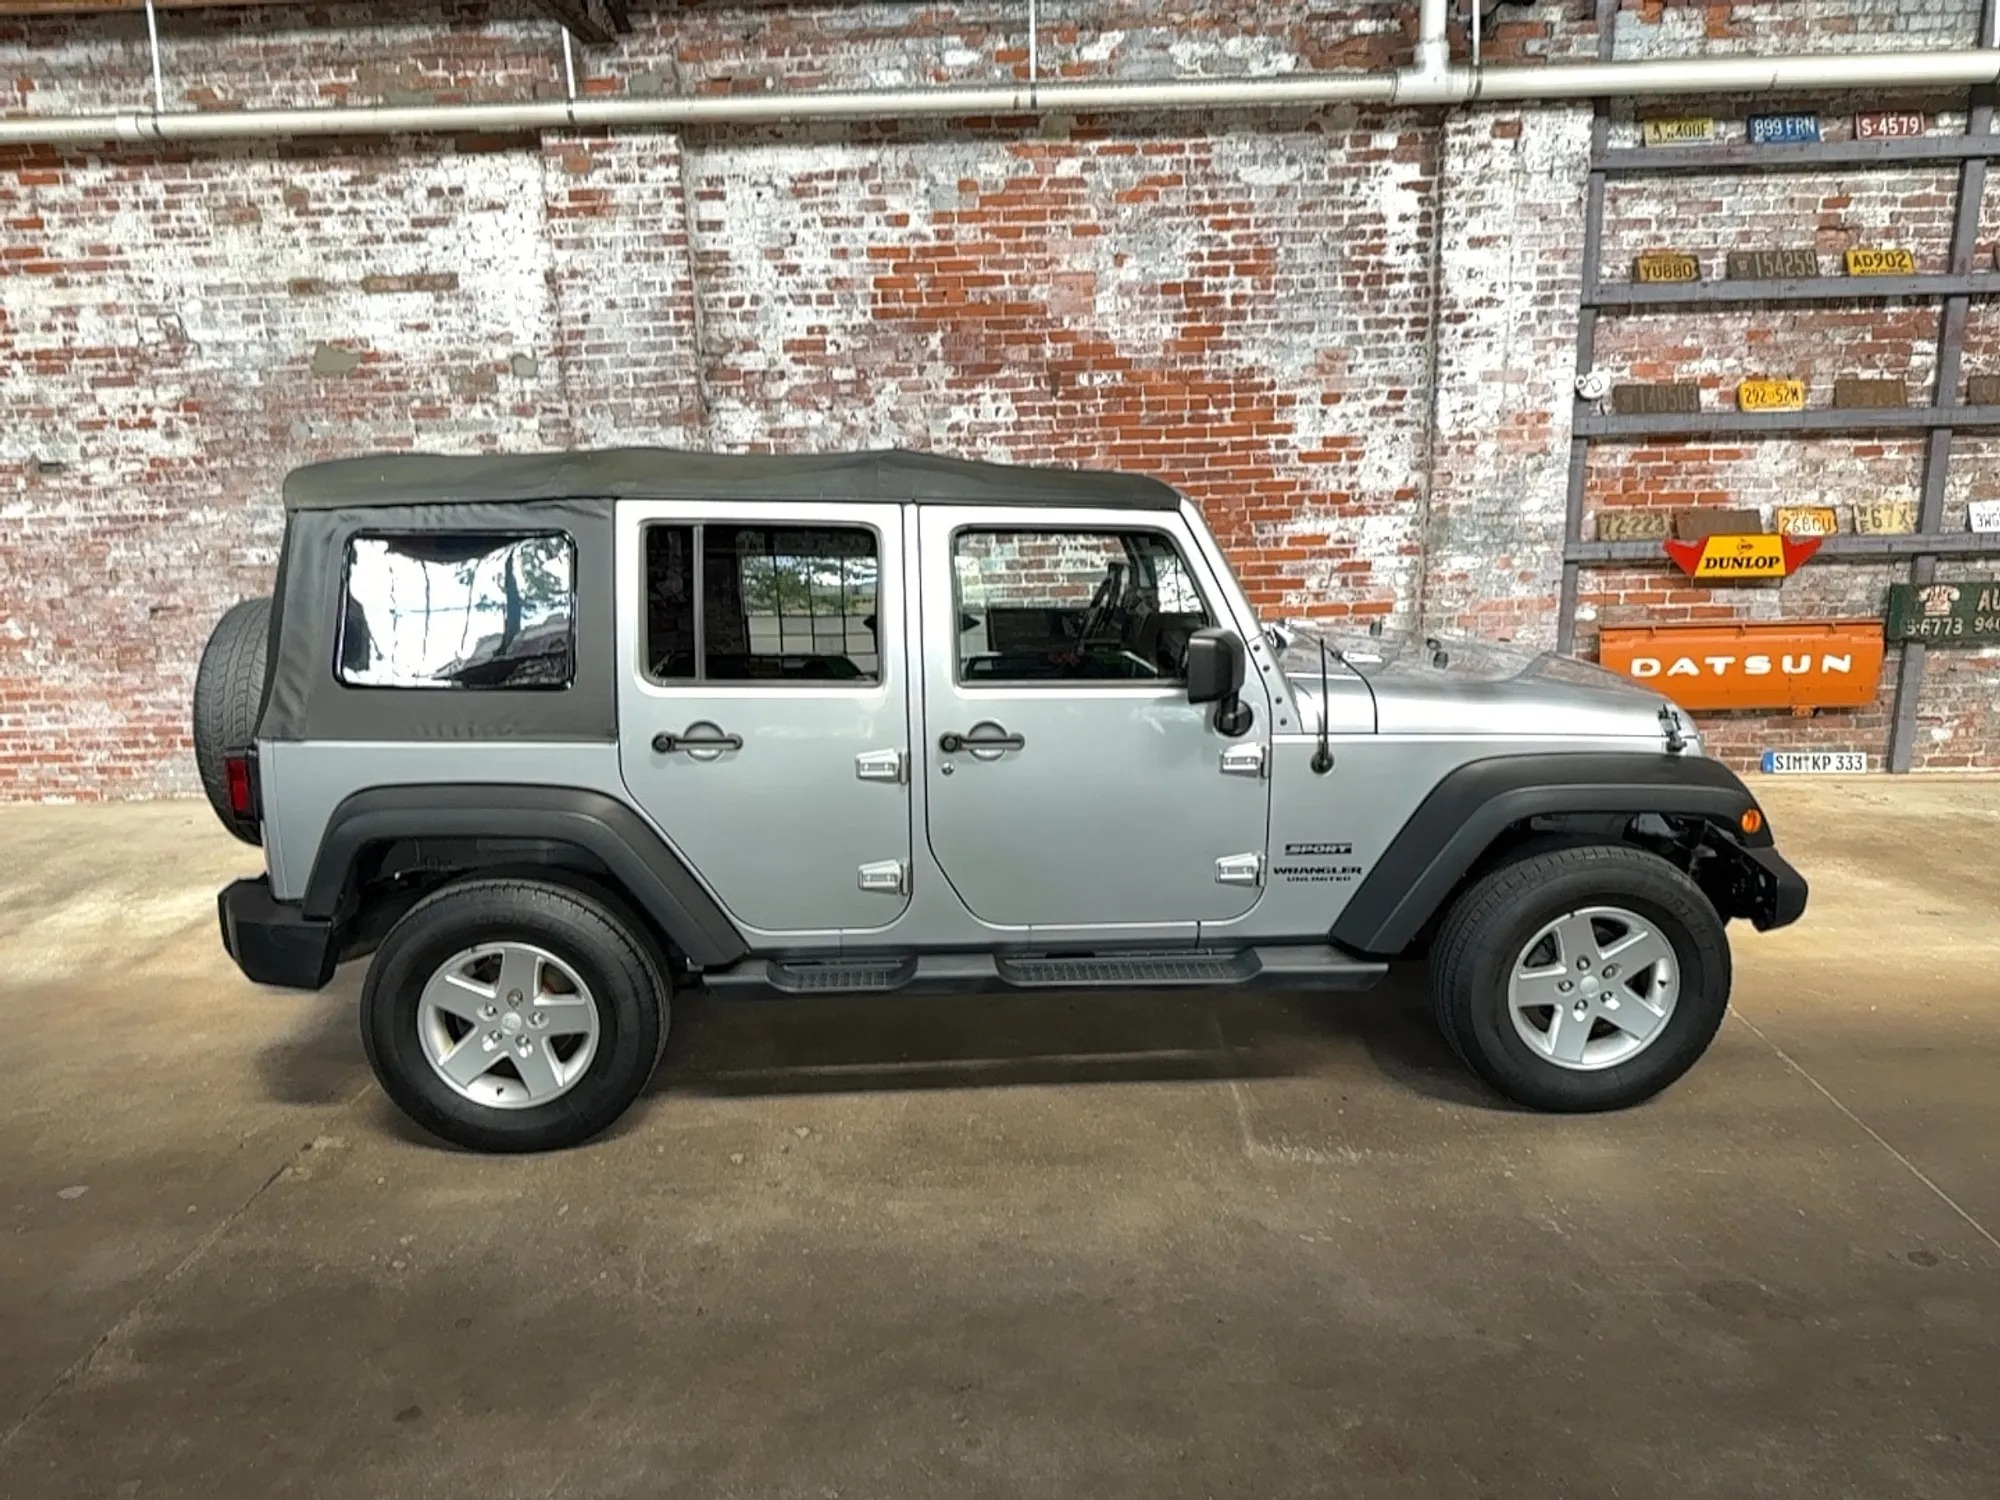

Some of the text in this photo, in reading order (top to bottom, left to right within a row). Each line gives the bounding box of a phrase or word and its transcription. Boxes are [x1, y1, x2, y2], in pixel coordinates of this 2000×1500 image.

[1754, 116, 1816, 136] 899 FRN
[1755, 248, 1817, 277] 154259
[1853, 251, 1909, 268] AD902
[1704, 555, 1780, 570] DUNLOP
[1630, 654, 1851, 678] DATSUN
[1775, 755, 1862, 771] SIM KP 333
[1286, 845, 1351, 854] SPORT
[1273, 867, 1363, 875] WRANGLER
